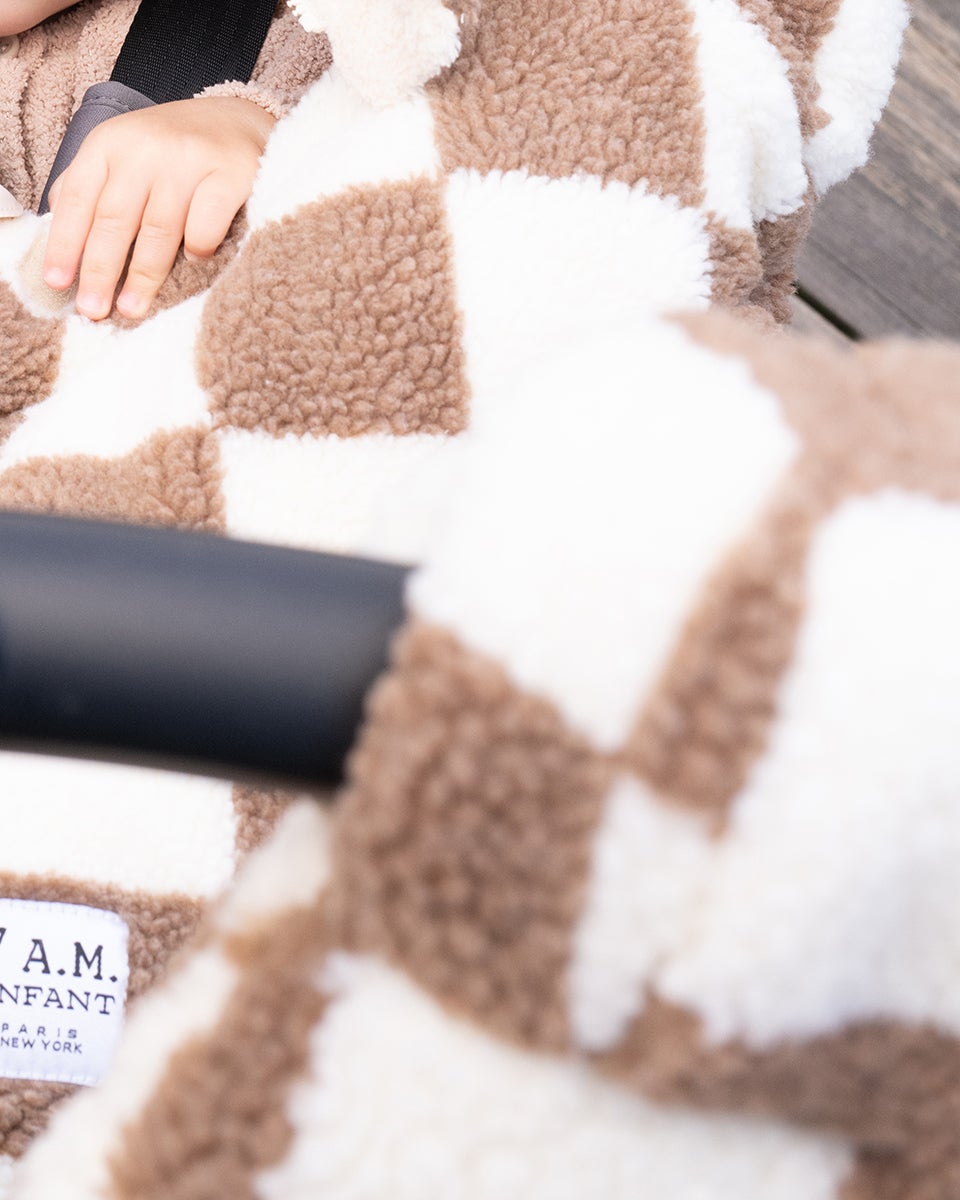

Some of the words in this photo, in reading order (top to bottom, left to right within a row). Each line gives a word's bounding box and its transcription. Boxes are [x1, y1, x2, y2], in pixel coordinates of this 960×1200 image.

[22, 938, 118, 983] A.M.
[1, 1022, 78, 1039] PARIS
[0, 1036, 36, 1049] NEW
[41, 1039, 83, 1054] YORK
